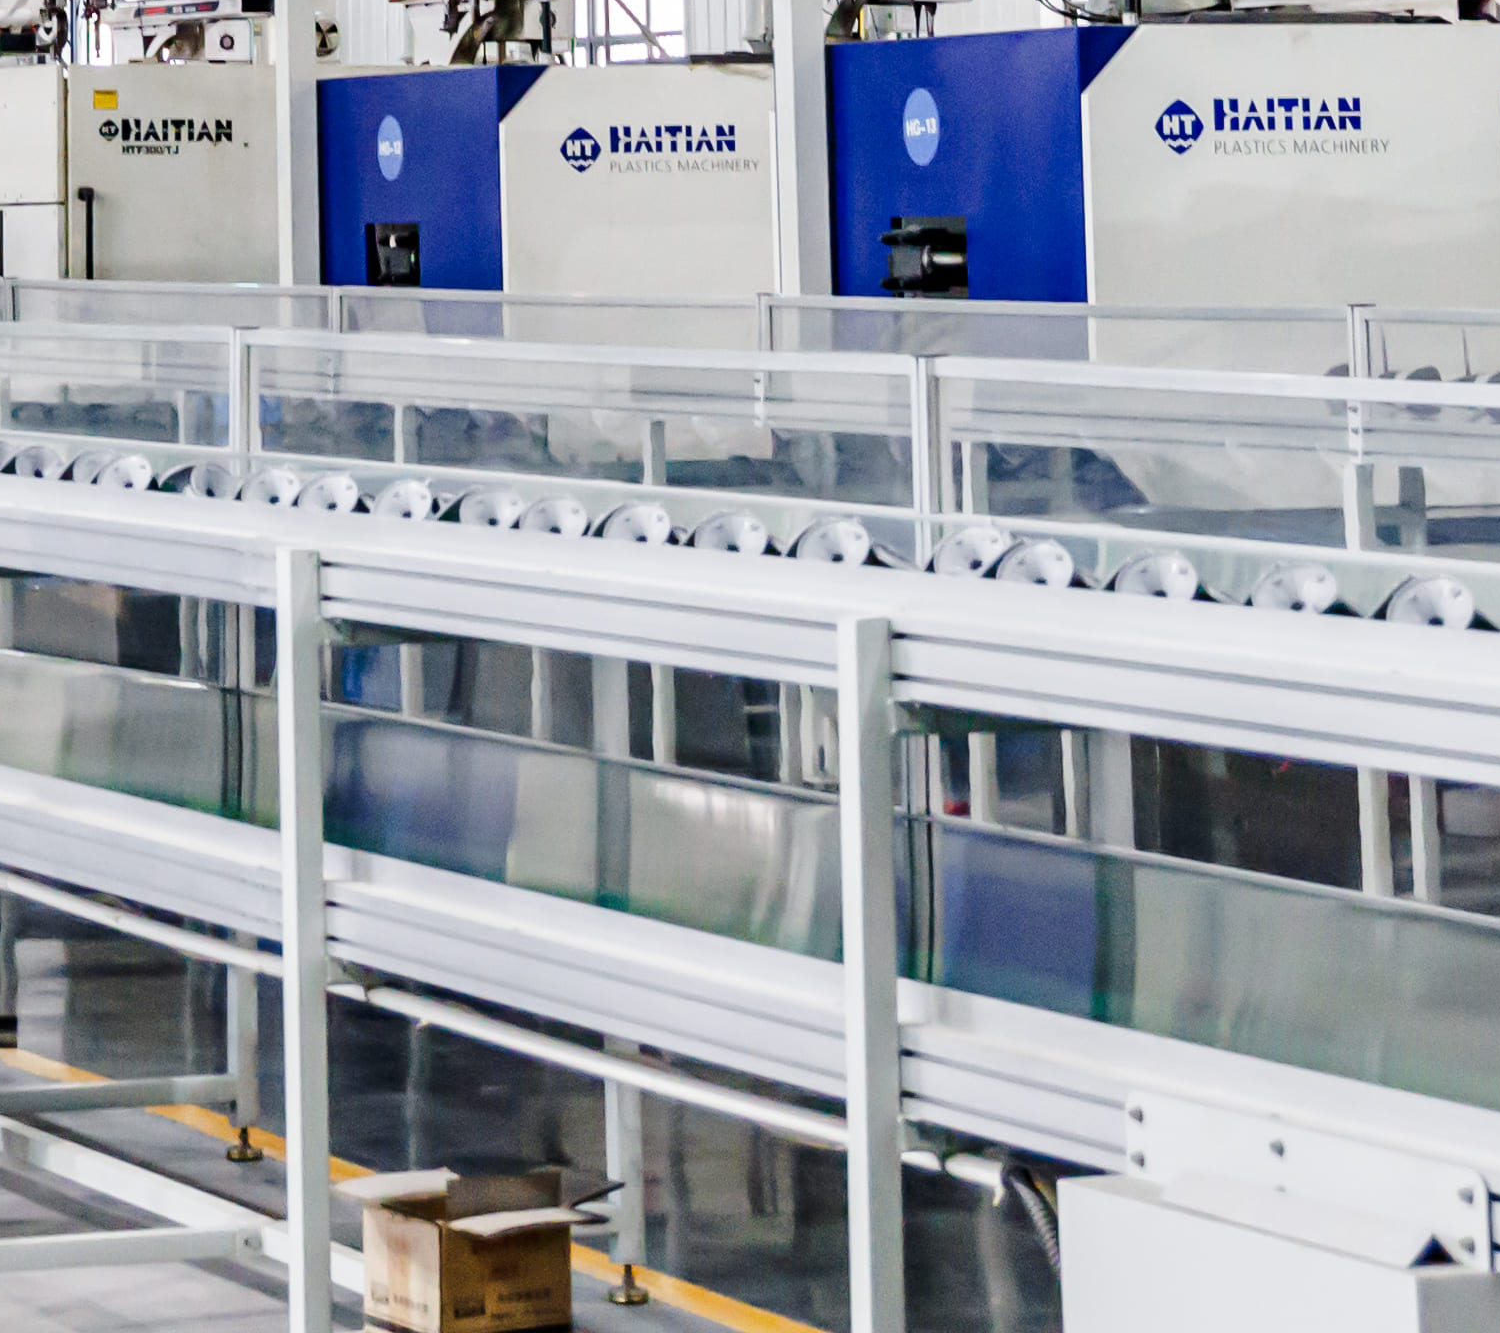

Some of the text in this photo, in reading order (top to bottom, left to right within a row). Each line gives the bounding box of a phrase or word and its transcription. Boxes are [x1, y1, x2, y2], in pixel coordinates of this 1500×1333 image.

[1213, 97, 1361, 131] HAITIAN
[121, 119, 232, 142] HAITIAN
[609, 124, 736, 153] HAITIAN
[1213, 137, 1390, 156] PLASTICS MACHINERY
[609, 159, 760, 173] PLASTICS MACHINERY
